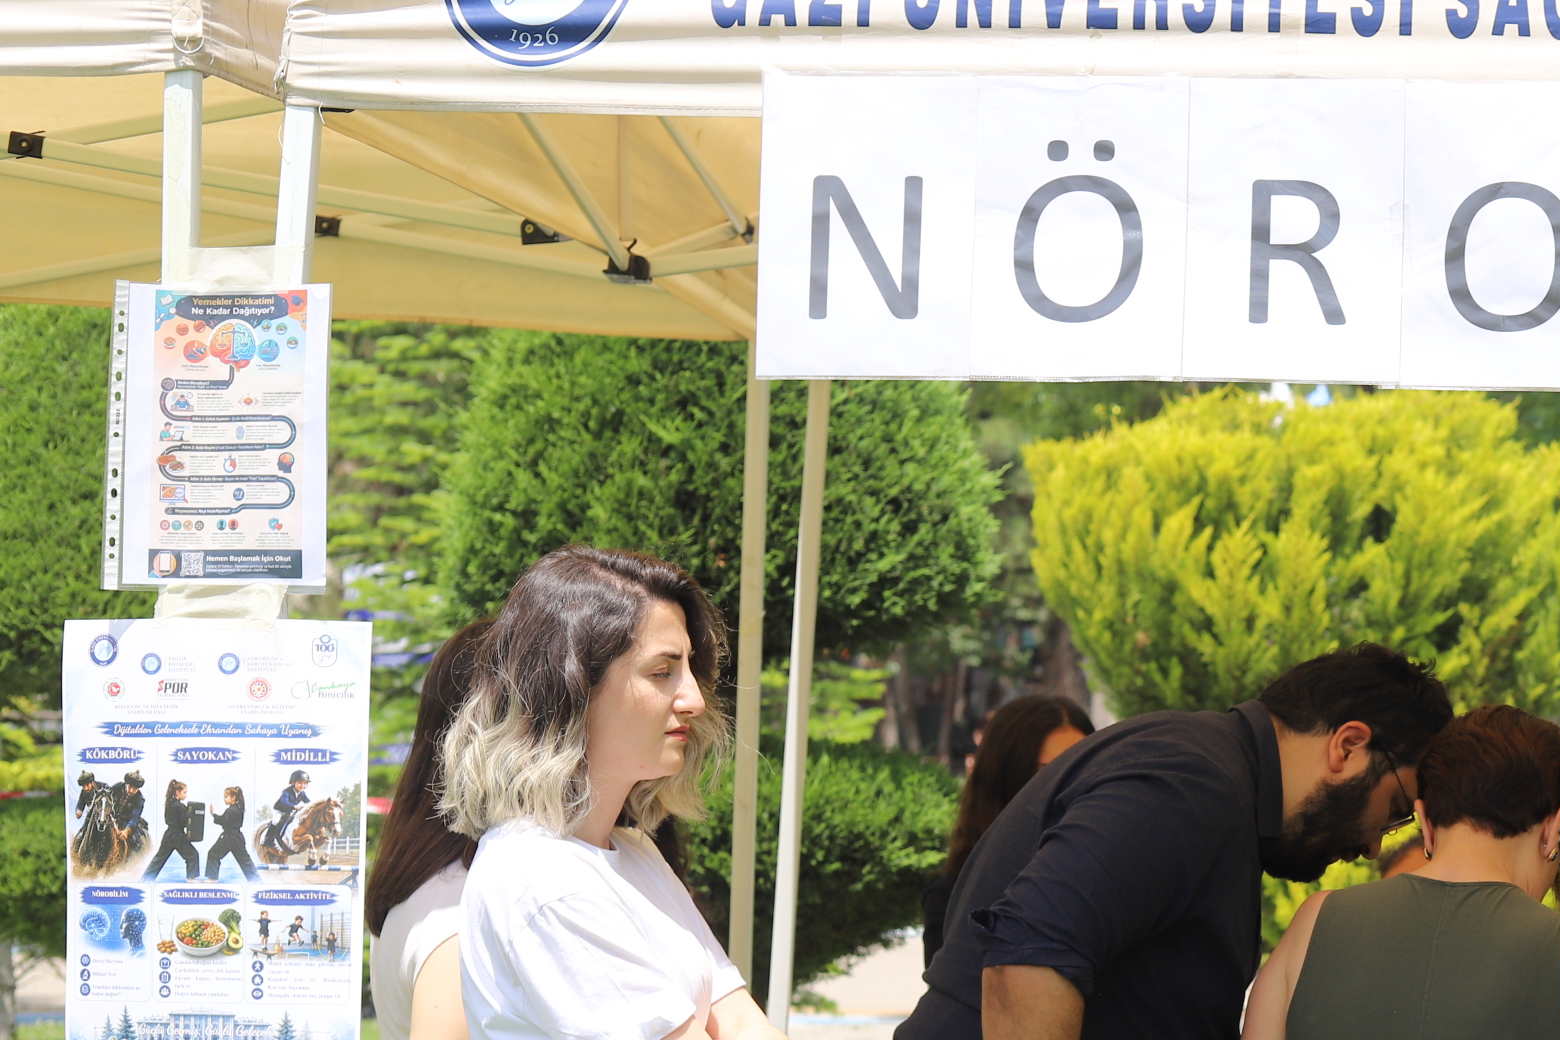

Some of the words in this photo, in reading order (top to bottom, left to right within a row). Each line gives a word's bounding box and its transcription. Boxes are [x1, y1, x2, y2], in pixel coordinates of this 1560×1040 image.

[509, 26, 559, 50] 1926
[234, 296, 274, 305] Dikkatimi
[233, 306, 275, 316] Dağıtıyor?
[262, 554, 273, 563] İçin
[318, 691, 354, 699] Binicilik
[114, 724, 152, 736] Dijitalden
[86, 748, 138, 759] KÖKBÖRÜ
[177, 751, 233, 760] SAYOKAN
[280, 750, 330, 762] MİDİLLİ
[92, 890, 128, 898] NÖROBİLİM
[163, 890, 198, 899] SAĞLIKLI
[258, 891, 292, 900] FİZİKSEL
